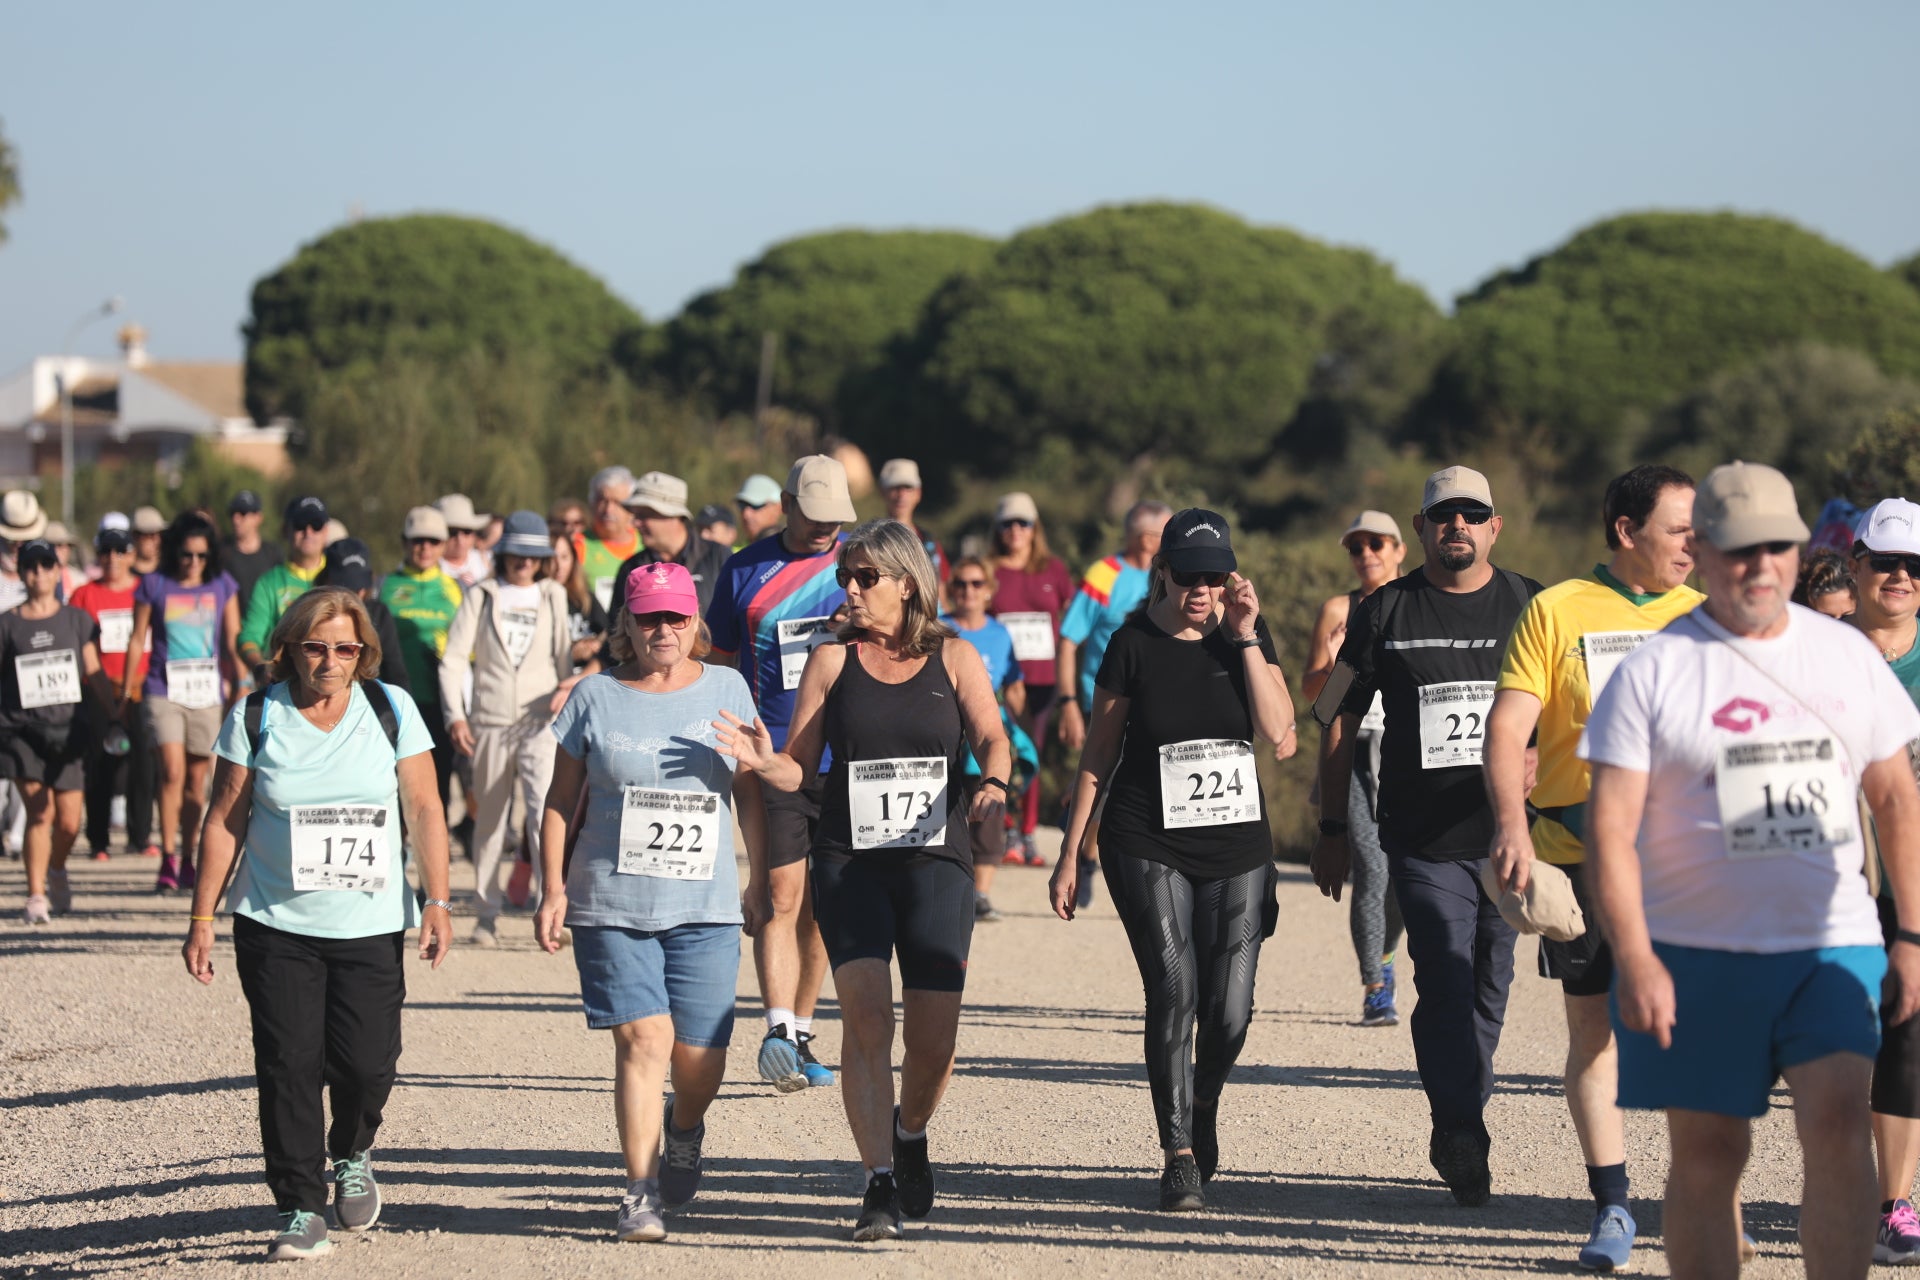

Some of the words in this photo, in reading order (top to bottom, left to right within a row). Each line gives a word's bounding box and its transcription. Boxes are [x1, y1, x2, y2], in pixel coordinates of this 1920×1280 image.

[760, 560, 784, 583] Joma
[37, 671, 69, 689] 189
[1436, 686, 1473, 694] CARRERA
[1431, 695, 1464, 703] MARCHA
[1466, 693, 1495, 701] SOLIDA
[1444, 712, 1483, 741] 22
[1177, 743, 1214, 753] CARRERA
[868, 763, 906, 772] CARRERA
[1187, 768, 1244, 800] 224
[636, 801, 671, 809] MARCHA
[643, 793, 681, 801] CARRERA
[878, 791, 933, 821] 173
[1763, 777, 1828, 820] 168
[646, 822, 703, 853] 222
[321, 836, 376, 867] 174
